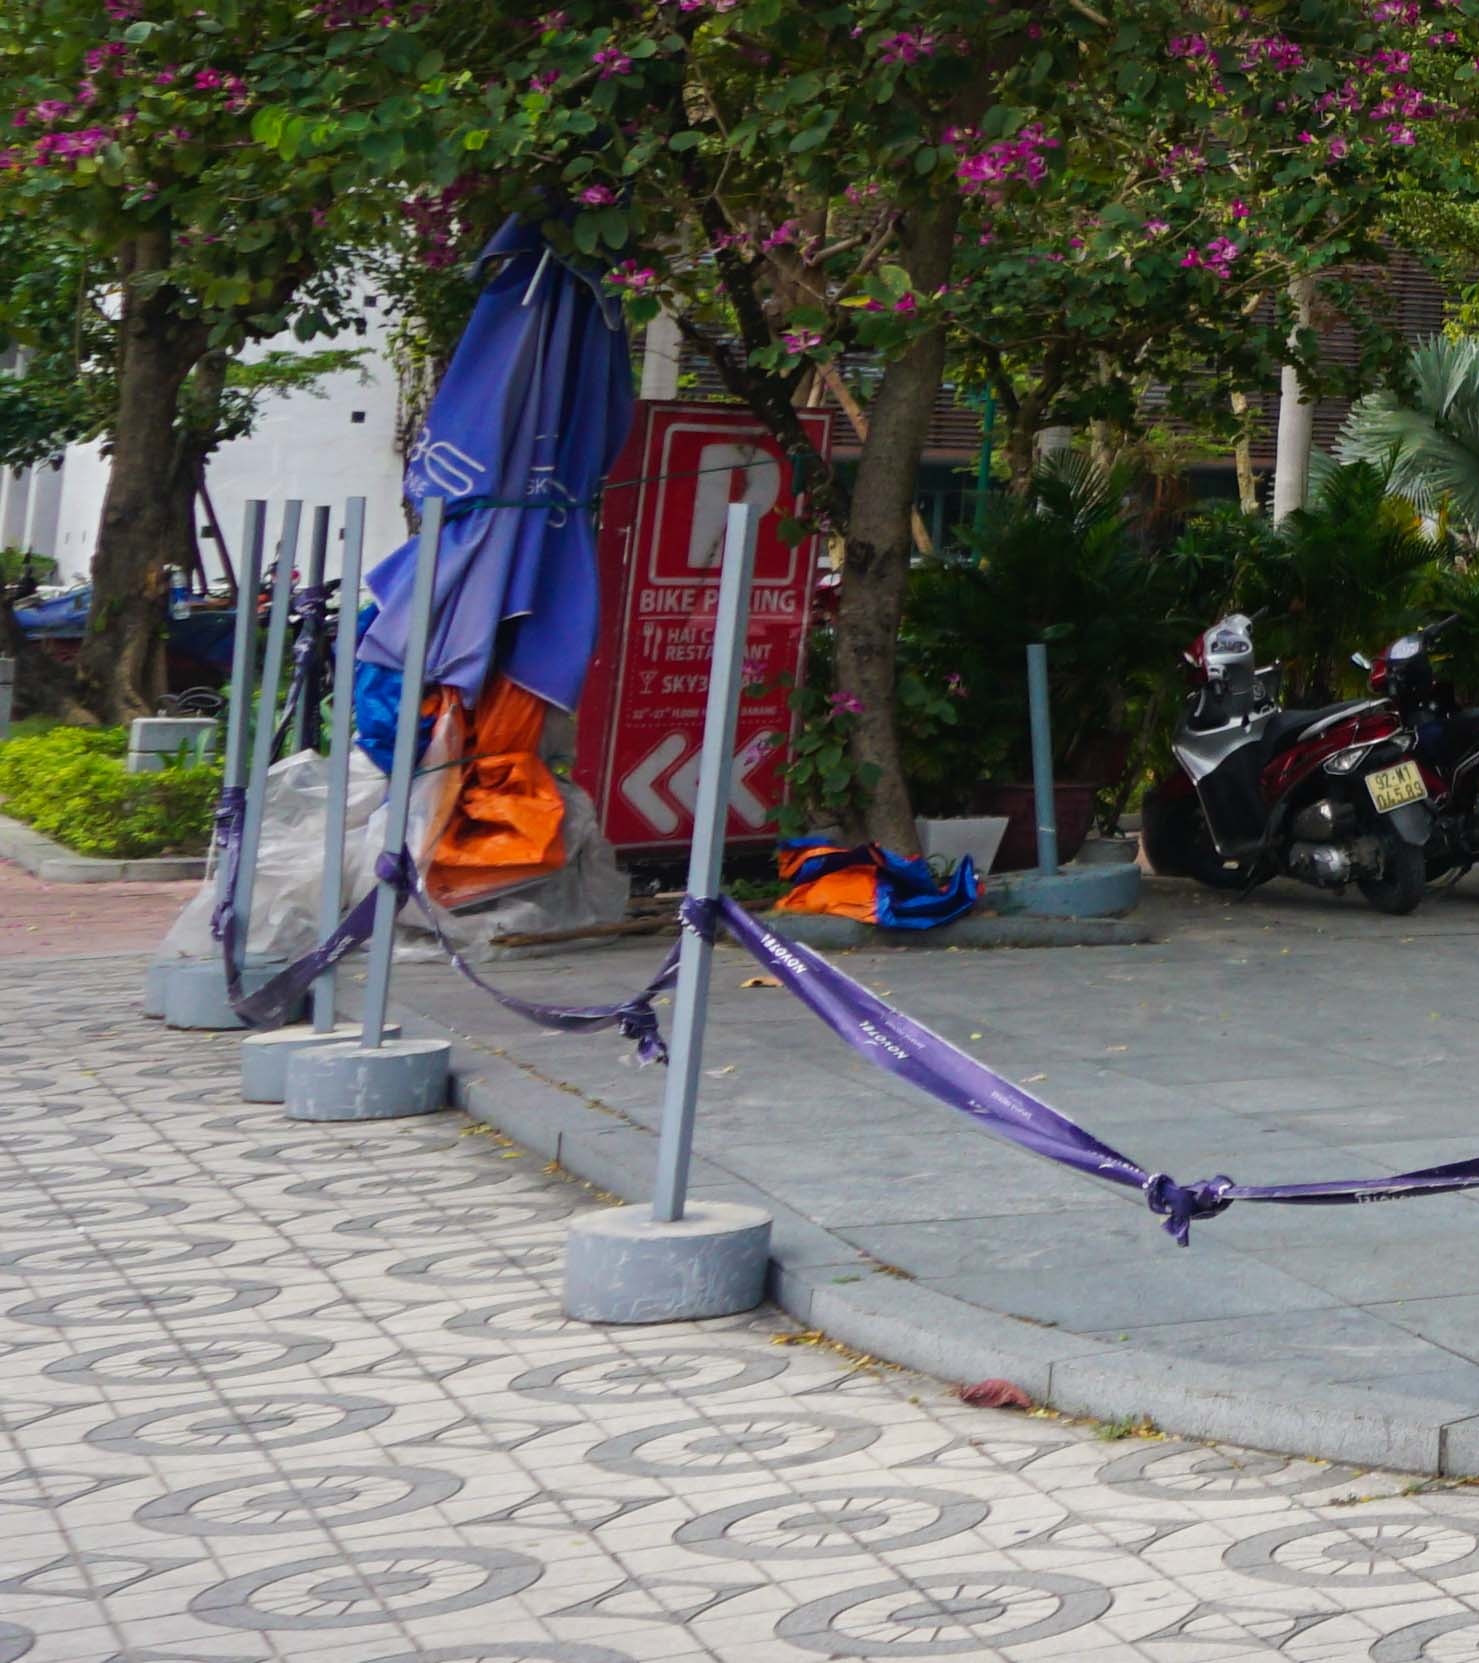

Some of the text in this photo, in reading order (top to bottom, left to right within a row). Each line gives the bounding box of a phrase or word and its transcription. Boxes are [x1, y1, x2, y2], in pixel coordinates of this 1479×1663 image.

[639, 589, 796, 614] BIKE PING
[665, 644, 773, 661] RESTAANT
